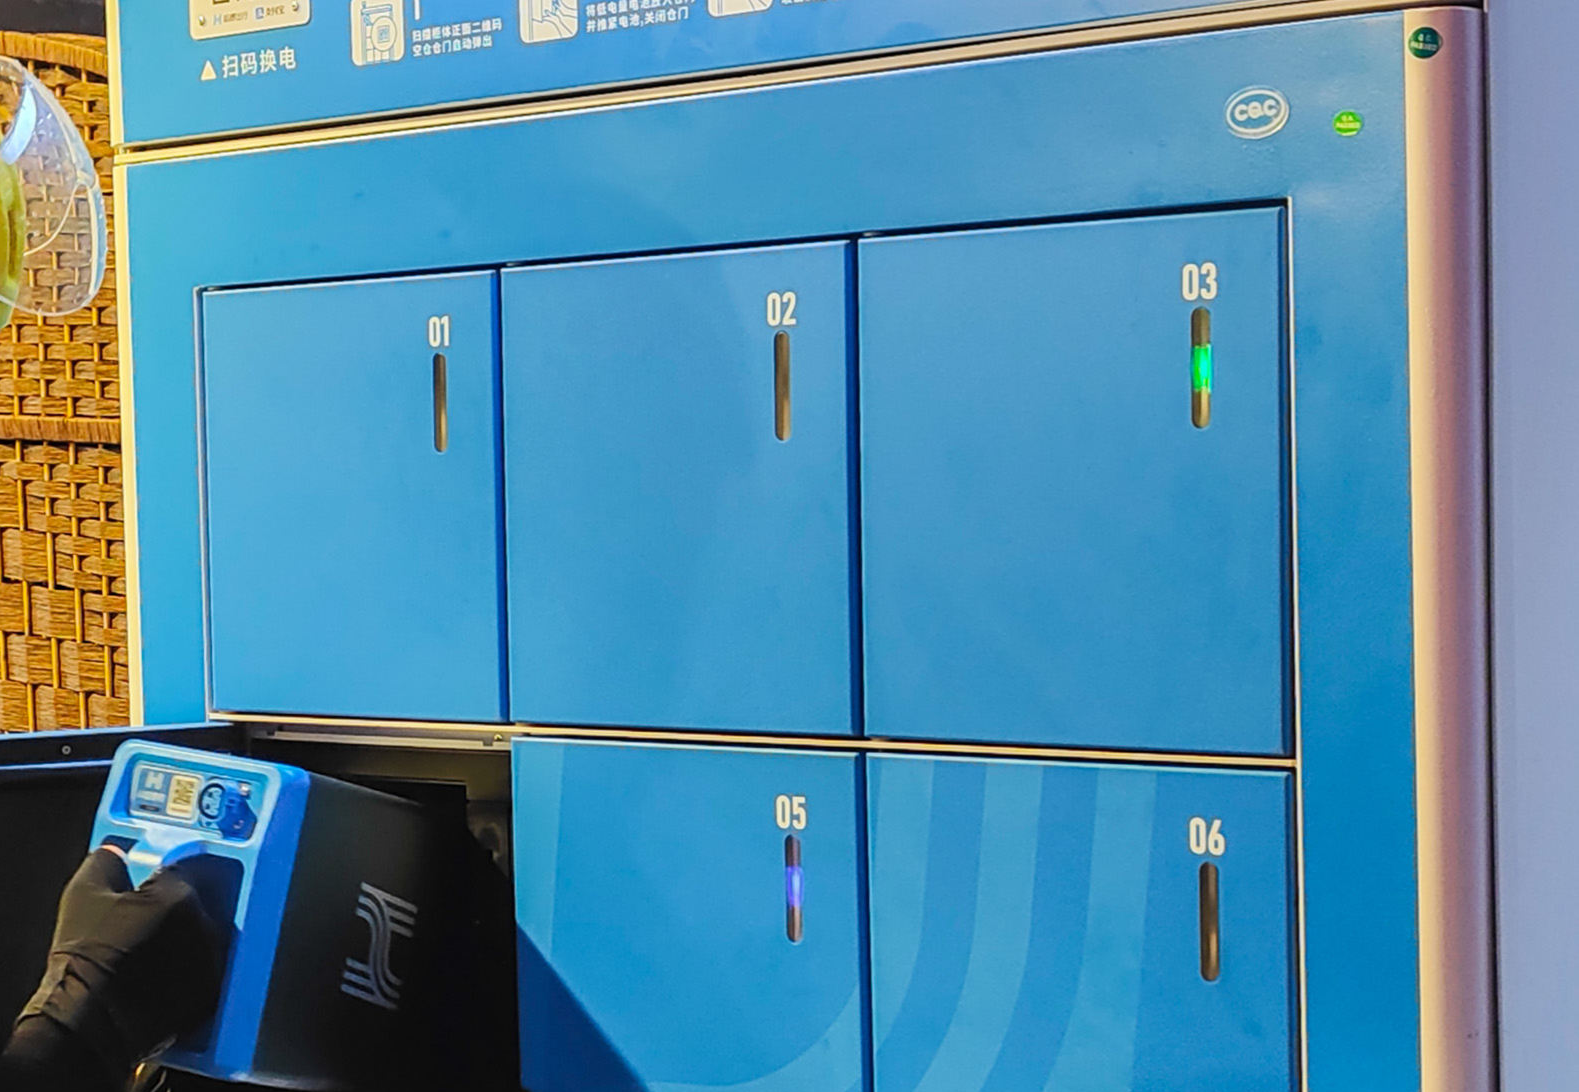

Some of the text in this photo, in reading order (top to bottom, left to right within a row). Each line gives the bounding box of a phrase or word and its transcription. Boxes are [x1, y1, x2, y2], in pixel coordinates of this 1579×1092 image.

[222, 45, 297, 79] 扫码换电
[1182, 262, 1218, 301] 03
[766, 291, 797, 327] 02
[428, 315, 450, 348] 01
[775, 794, 807, 830] 05
[1189, 816, 1227, 856] 06
